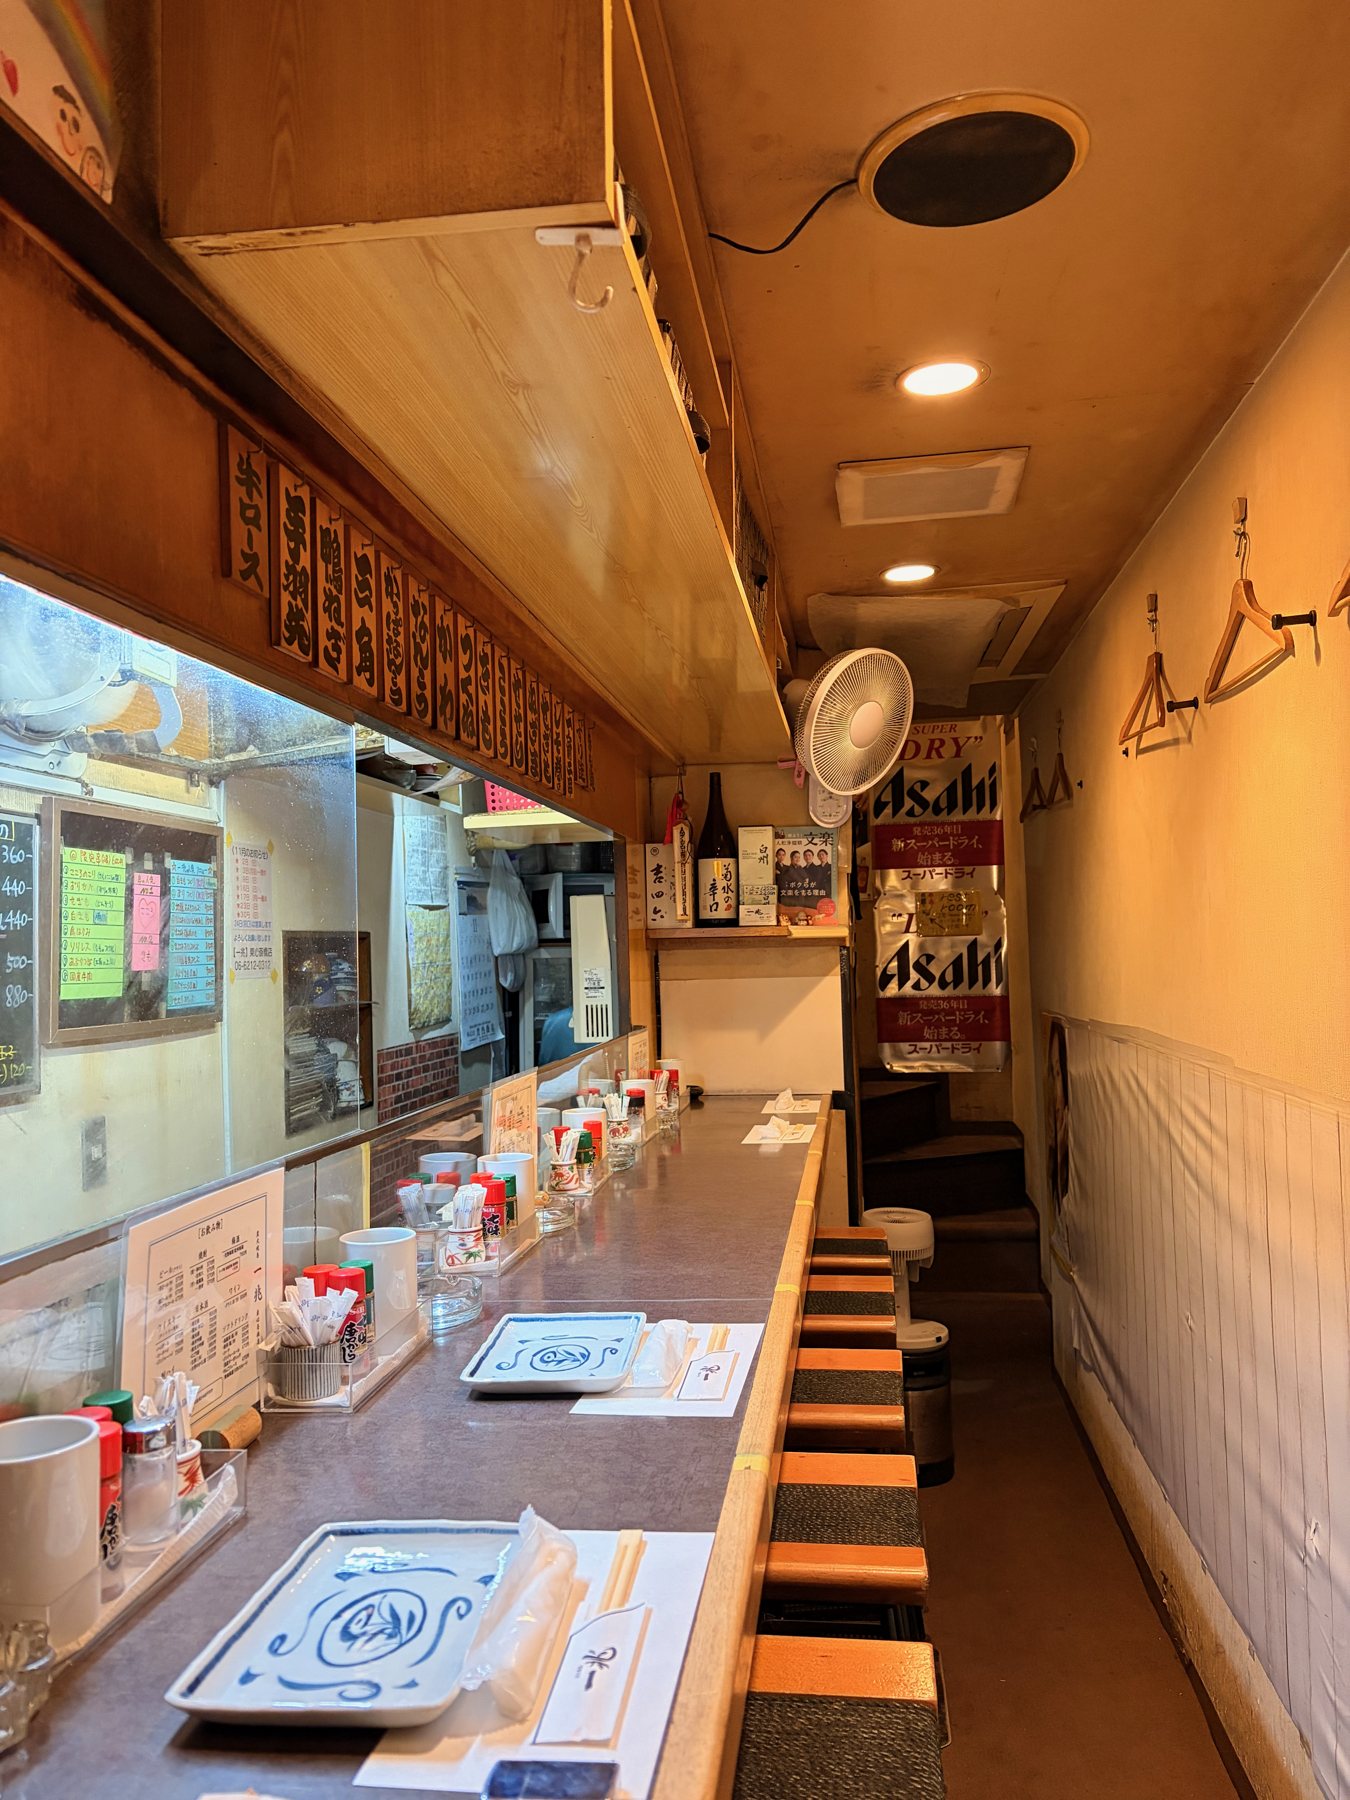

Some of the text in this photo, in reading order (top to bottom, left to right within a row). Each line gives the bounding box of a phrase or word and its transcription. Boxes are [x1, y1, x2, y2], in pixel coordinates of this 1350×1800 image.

[911, 723, 958, 735] SUPER
[873, 760, 998, 820] Asahi
[803, 831, 834, 847] 文楽
[758, 844, 769, 865] 白州
[721, 862, 735, 903] 菊水の
[901, 867, 977, 881] スーパードライ
[704, 878, 719, 913] 辛口
[878, 936, 1004, 993] Asahi
[907, 1042, 983, 1056] スーパードライ
[487, 1213, 501, 1236] 七味
